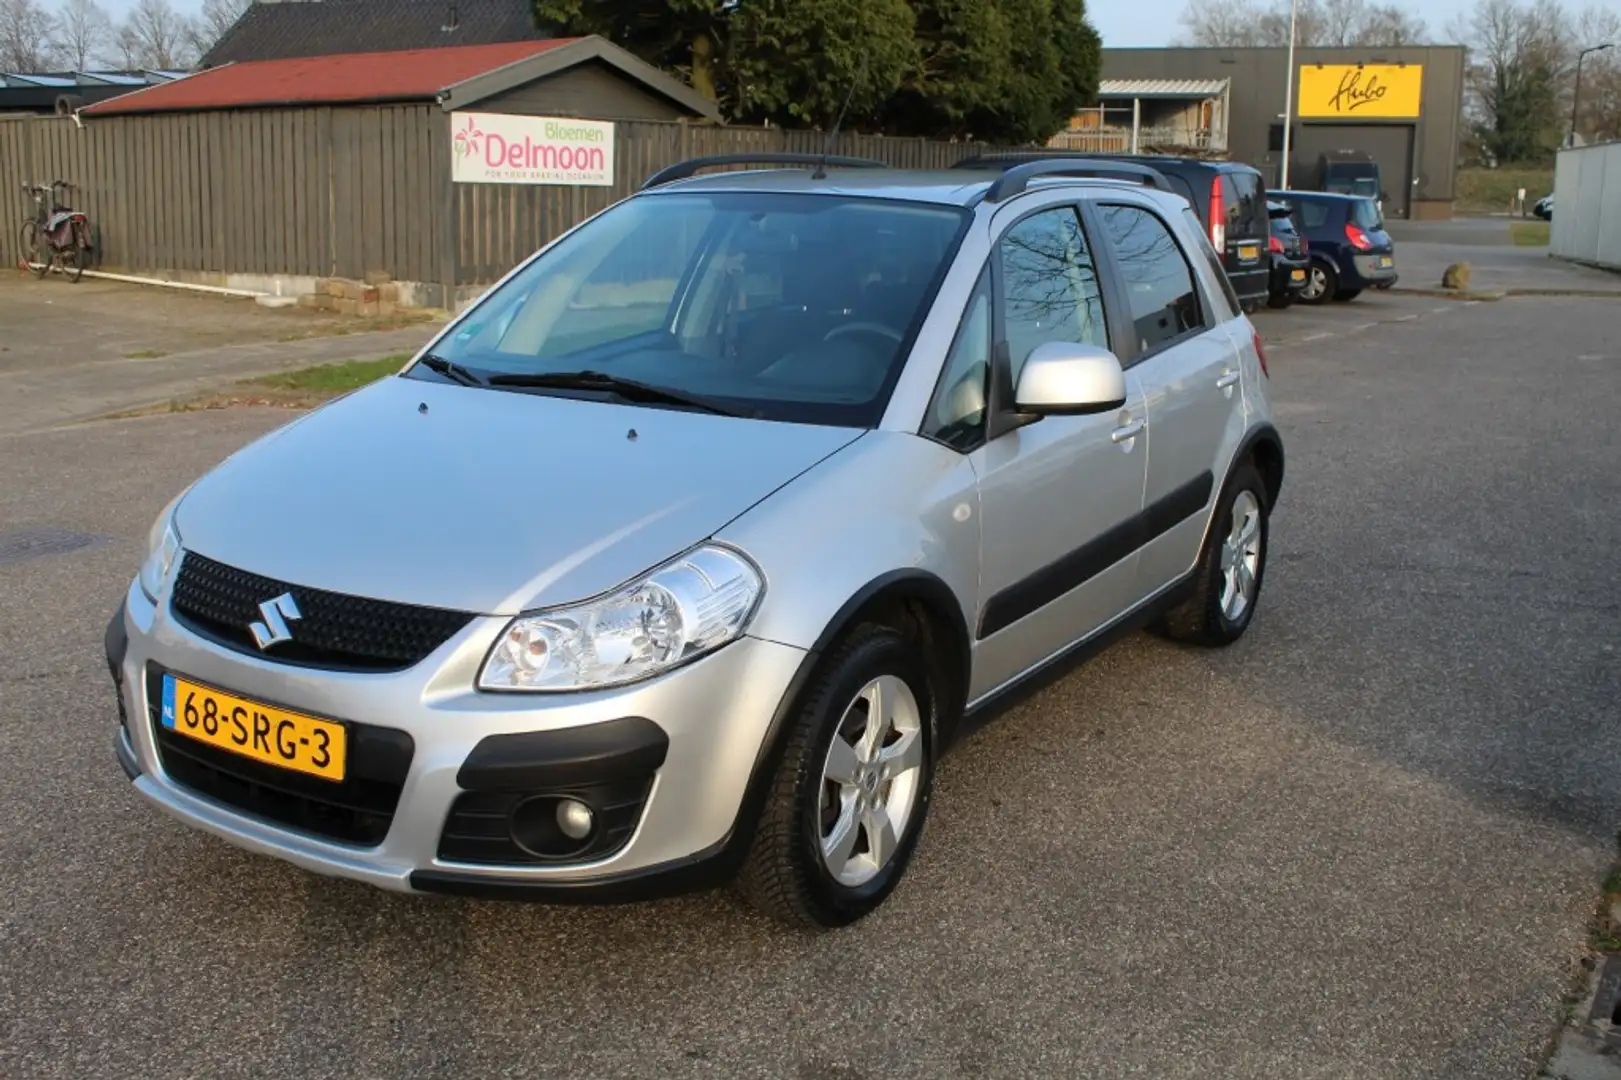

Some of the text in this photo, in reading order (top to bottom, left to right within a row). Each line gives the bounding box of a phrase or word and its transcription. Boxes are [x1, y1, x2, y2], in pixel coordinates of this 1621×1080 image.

[1328, 69, 1387, 111] Hubo
[545, 122, 604, 141] Bloemen
[485, 133, 604, 171] Delmoon
[163, 705, 175, 719] NL
[184, 692, 331, 768] 68-SRG-3
